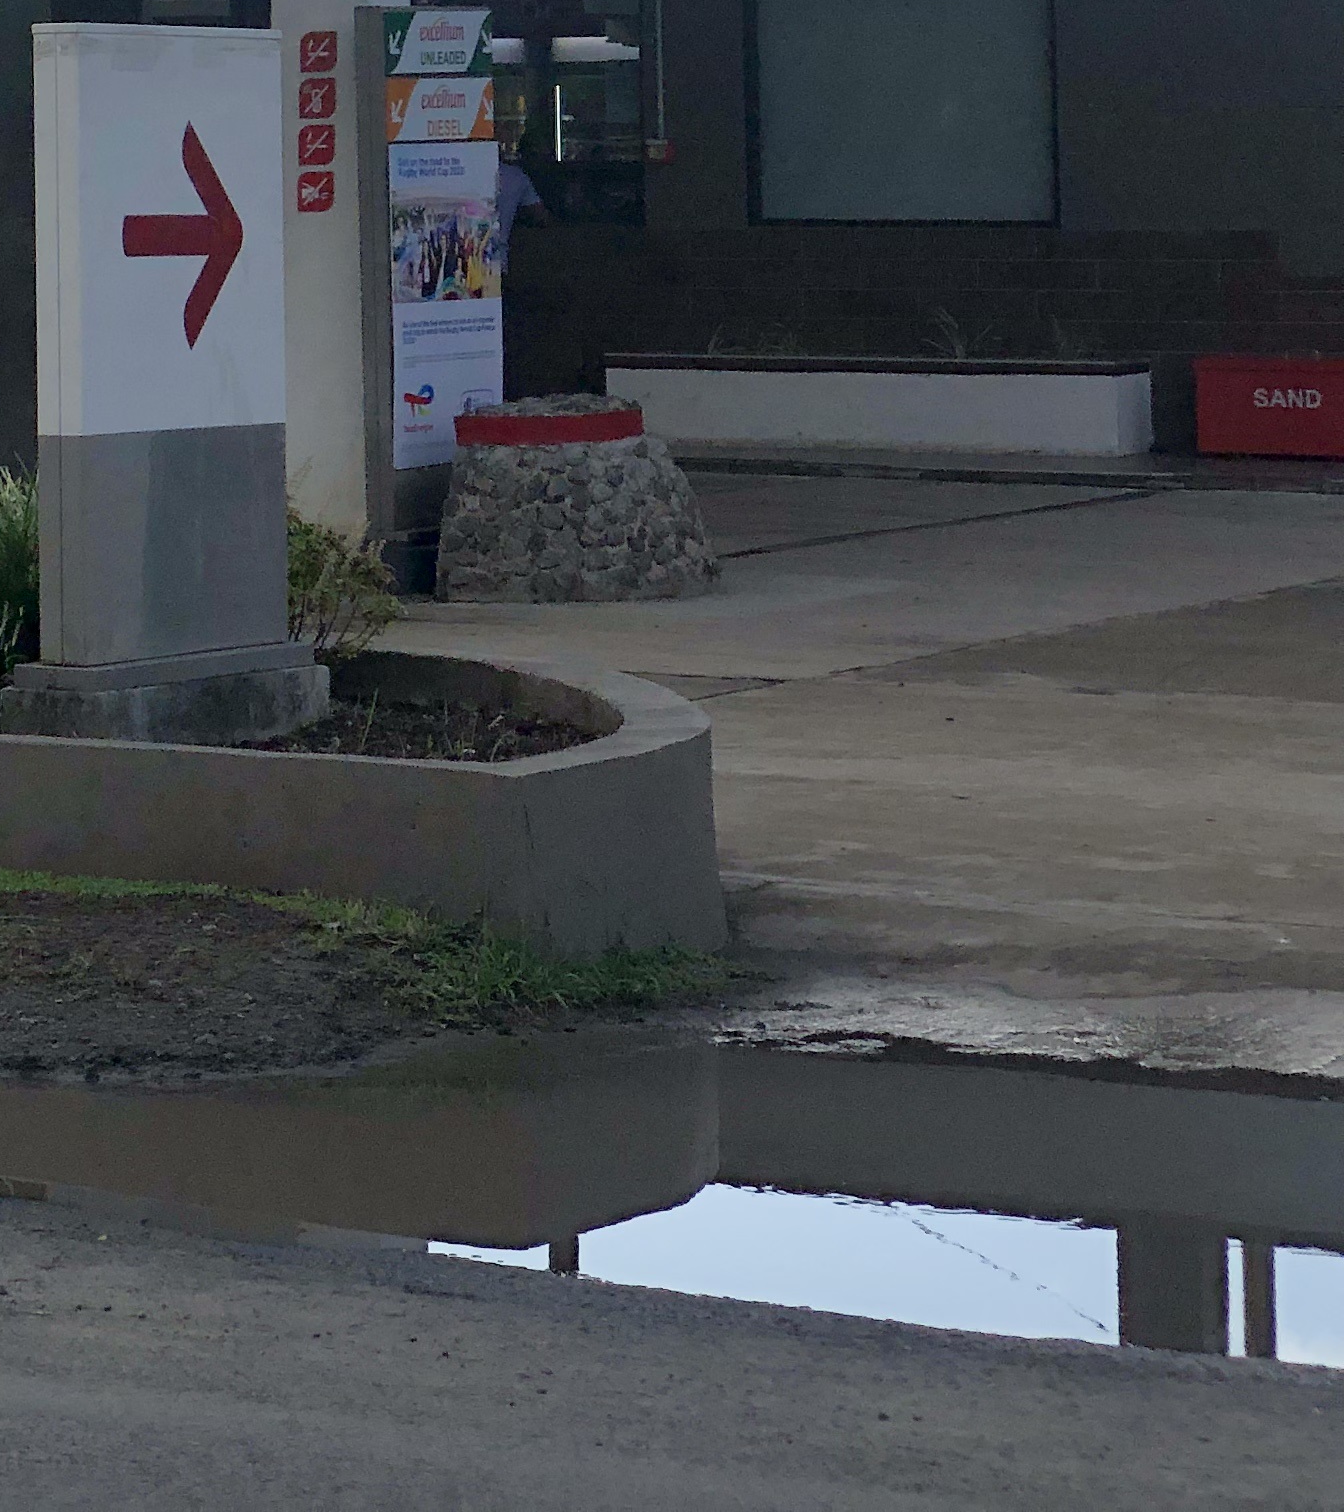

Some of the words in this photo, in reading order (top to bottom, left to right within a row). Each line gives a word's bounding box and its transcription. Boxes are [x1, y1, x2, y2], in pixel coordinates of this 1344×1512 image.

[420, 50, 467, 66] UNLEADED
[427, 119, 463, 137] DIESEL
[1252, 387, 1322, 409] SAND
